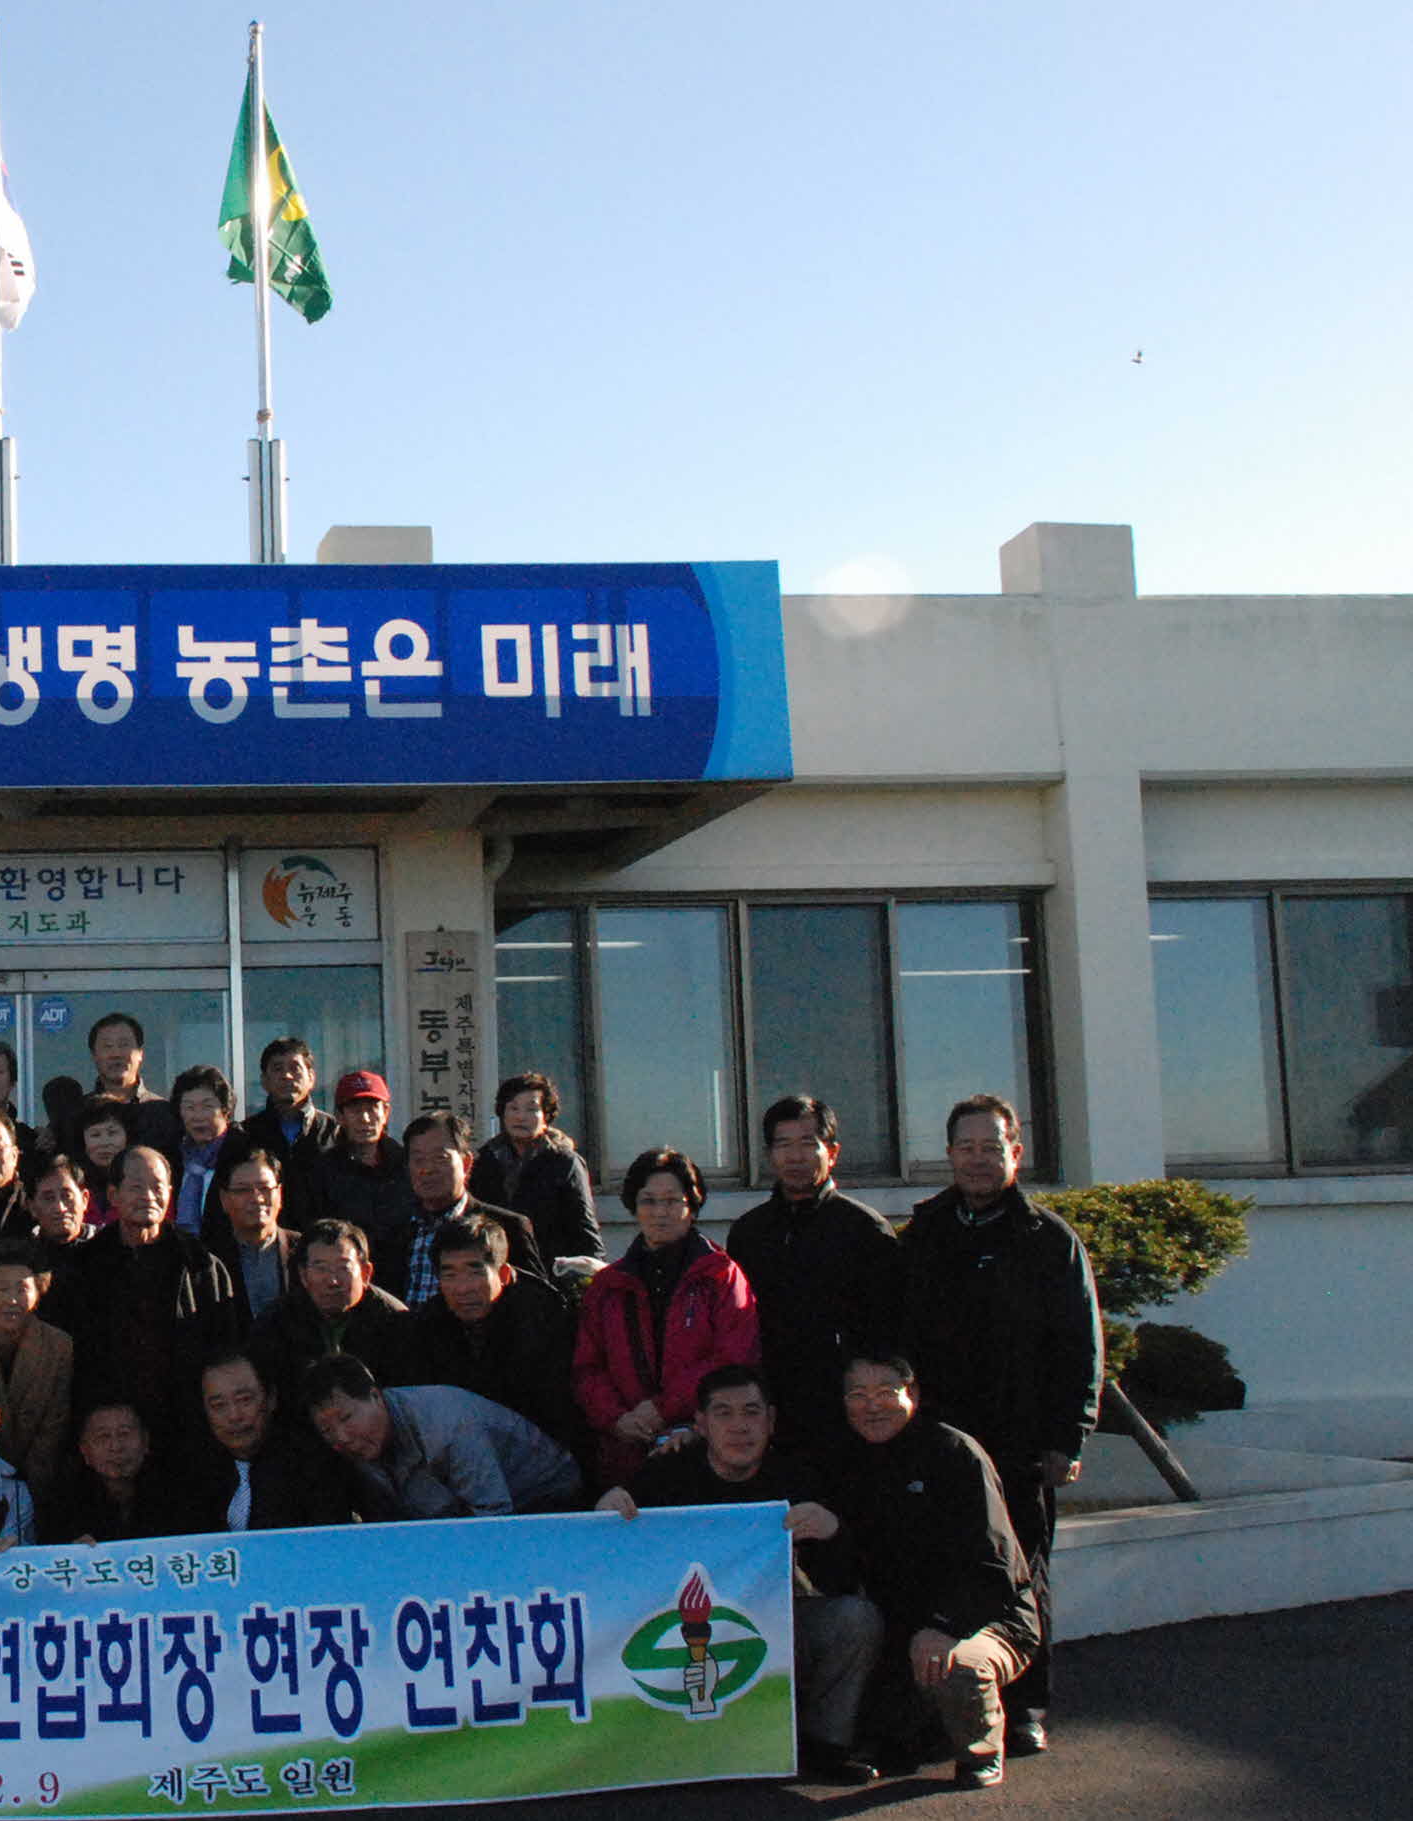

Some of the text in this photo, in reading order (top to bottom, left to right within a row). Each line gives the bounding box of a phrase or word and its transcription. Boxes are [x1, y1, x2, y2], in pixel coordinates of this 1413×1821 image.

[175, 617, 443, 725] 농촌은
[480, 622, 652, 719] 미래
[297, 882, 354, 904] 뉴제주
[423, 950, 465, 972] Jeju
[40, 1008, 67, 1022] ADT
[243, 1606, 369, 1738] 현장
[397, 1592, 584, 1727] 연찬회
[152, 1761, 354, 1800] 제주도 일원
